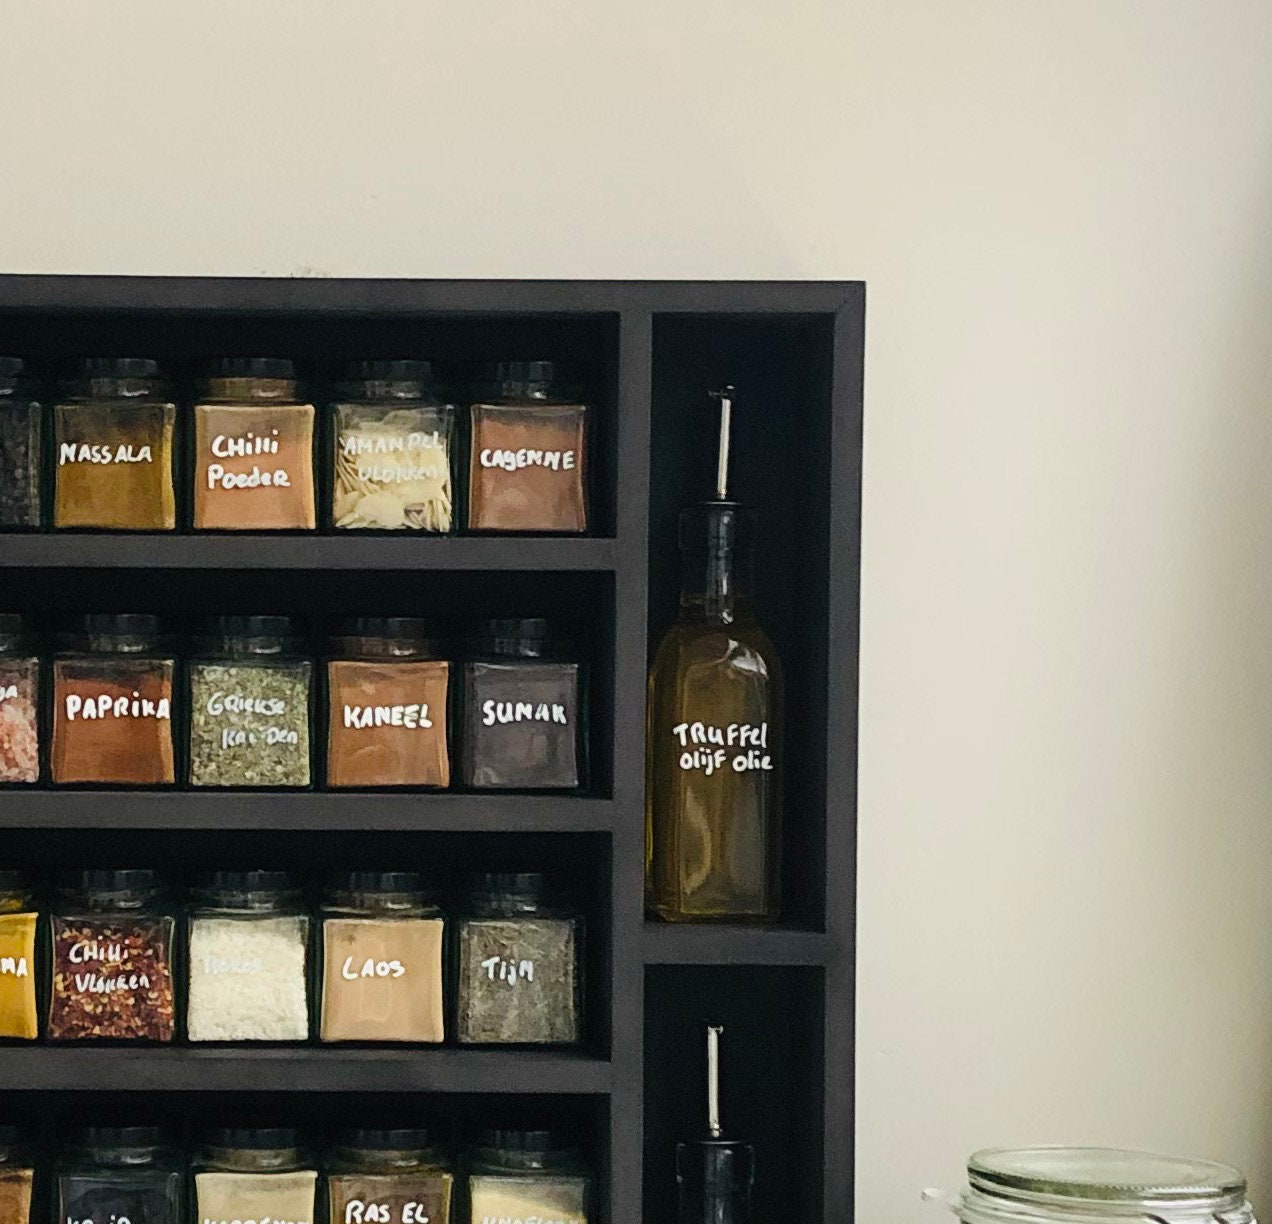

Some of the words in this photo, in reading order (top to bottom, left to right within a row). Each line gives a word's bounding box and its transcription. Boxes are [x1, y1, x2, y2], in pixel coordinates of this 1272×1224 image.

[59, 442, 153, 466] MASSALA
[343, 704, 434, 730] KANEEL
[482, 700, 568, 726] SUMAK
[345, 1200, 391, 1224] RAS
[402, 1202, 429, 1224] EL
